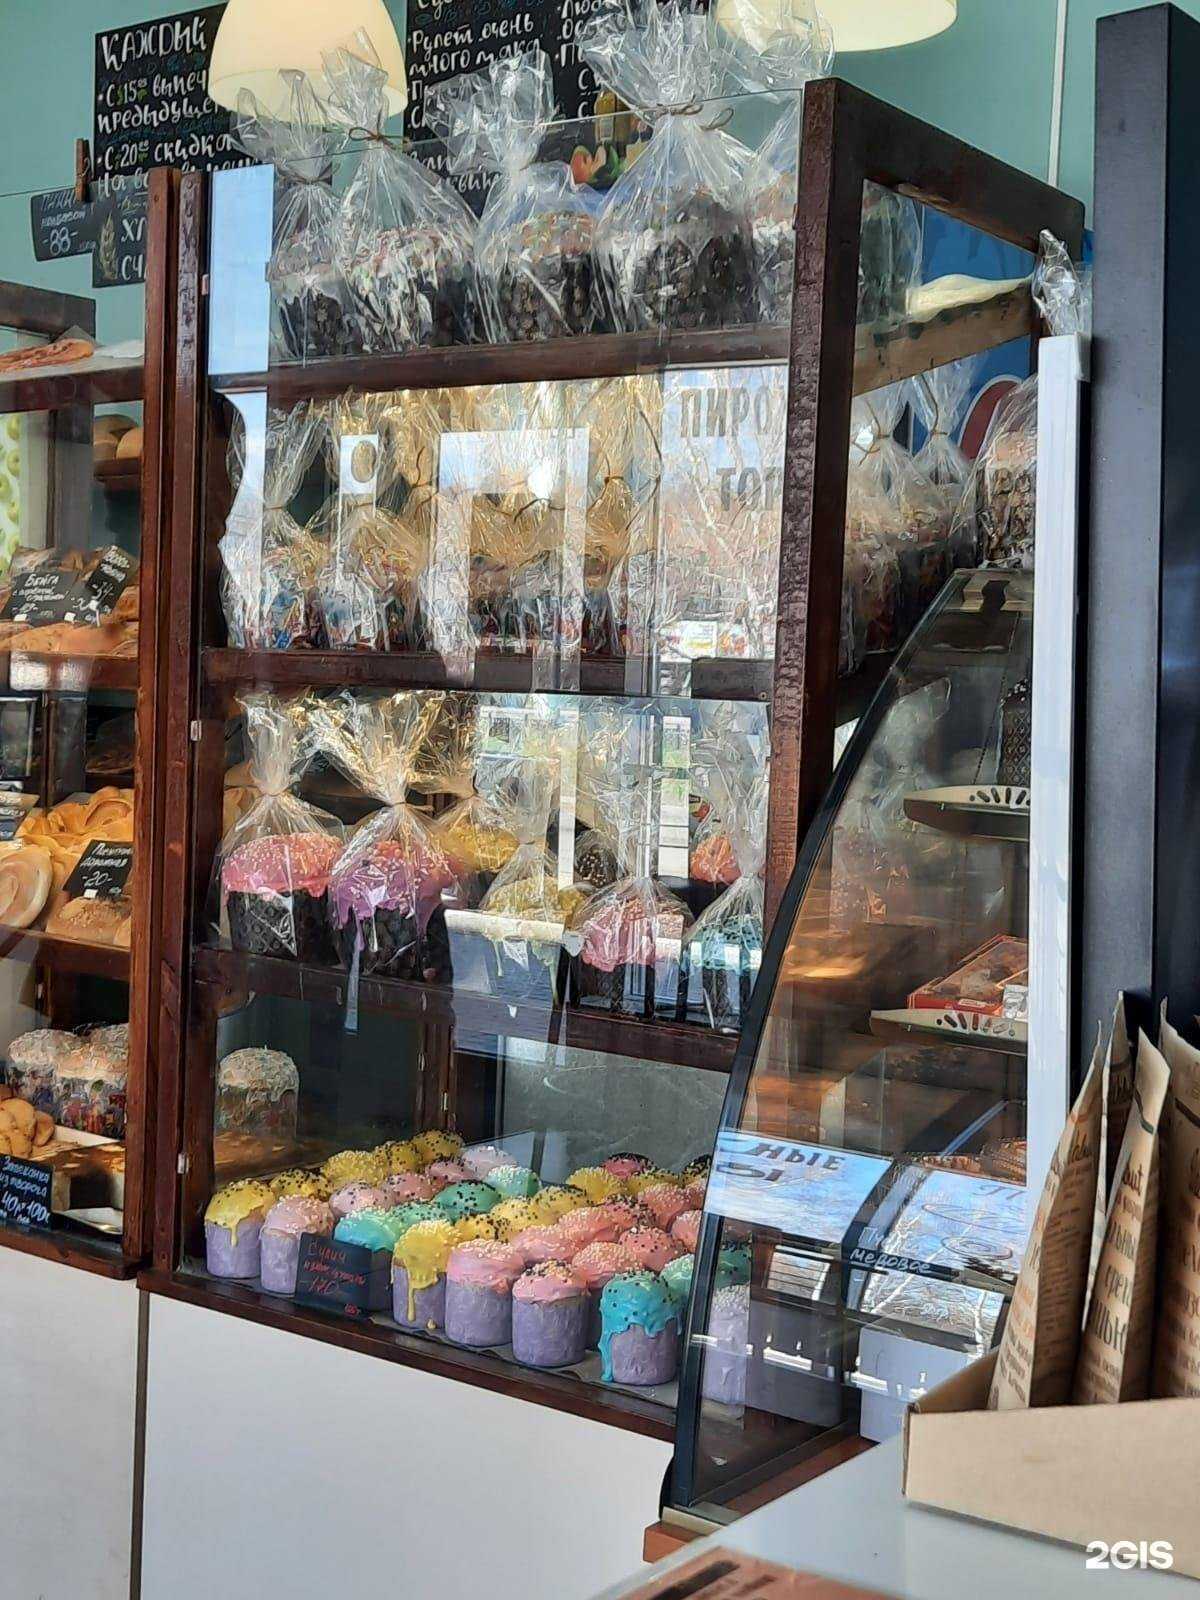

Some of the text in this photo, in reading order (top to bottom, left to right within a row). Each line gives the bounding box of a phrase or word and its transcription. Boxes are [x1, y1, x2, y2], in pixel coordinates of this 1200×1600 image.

[412, 13, 534, 61] Рулет очень
[409, 49, 471, 77] много
